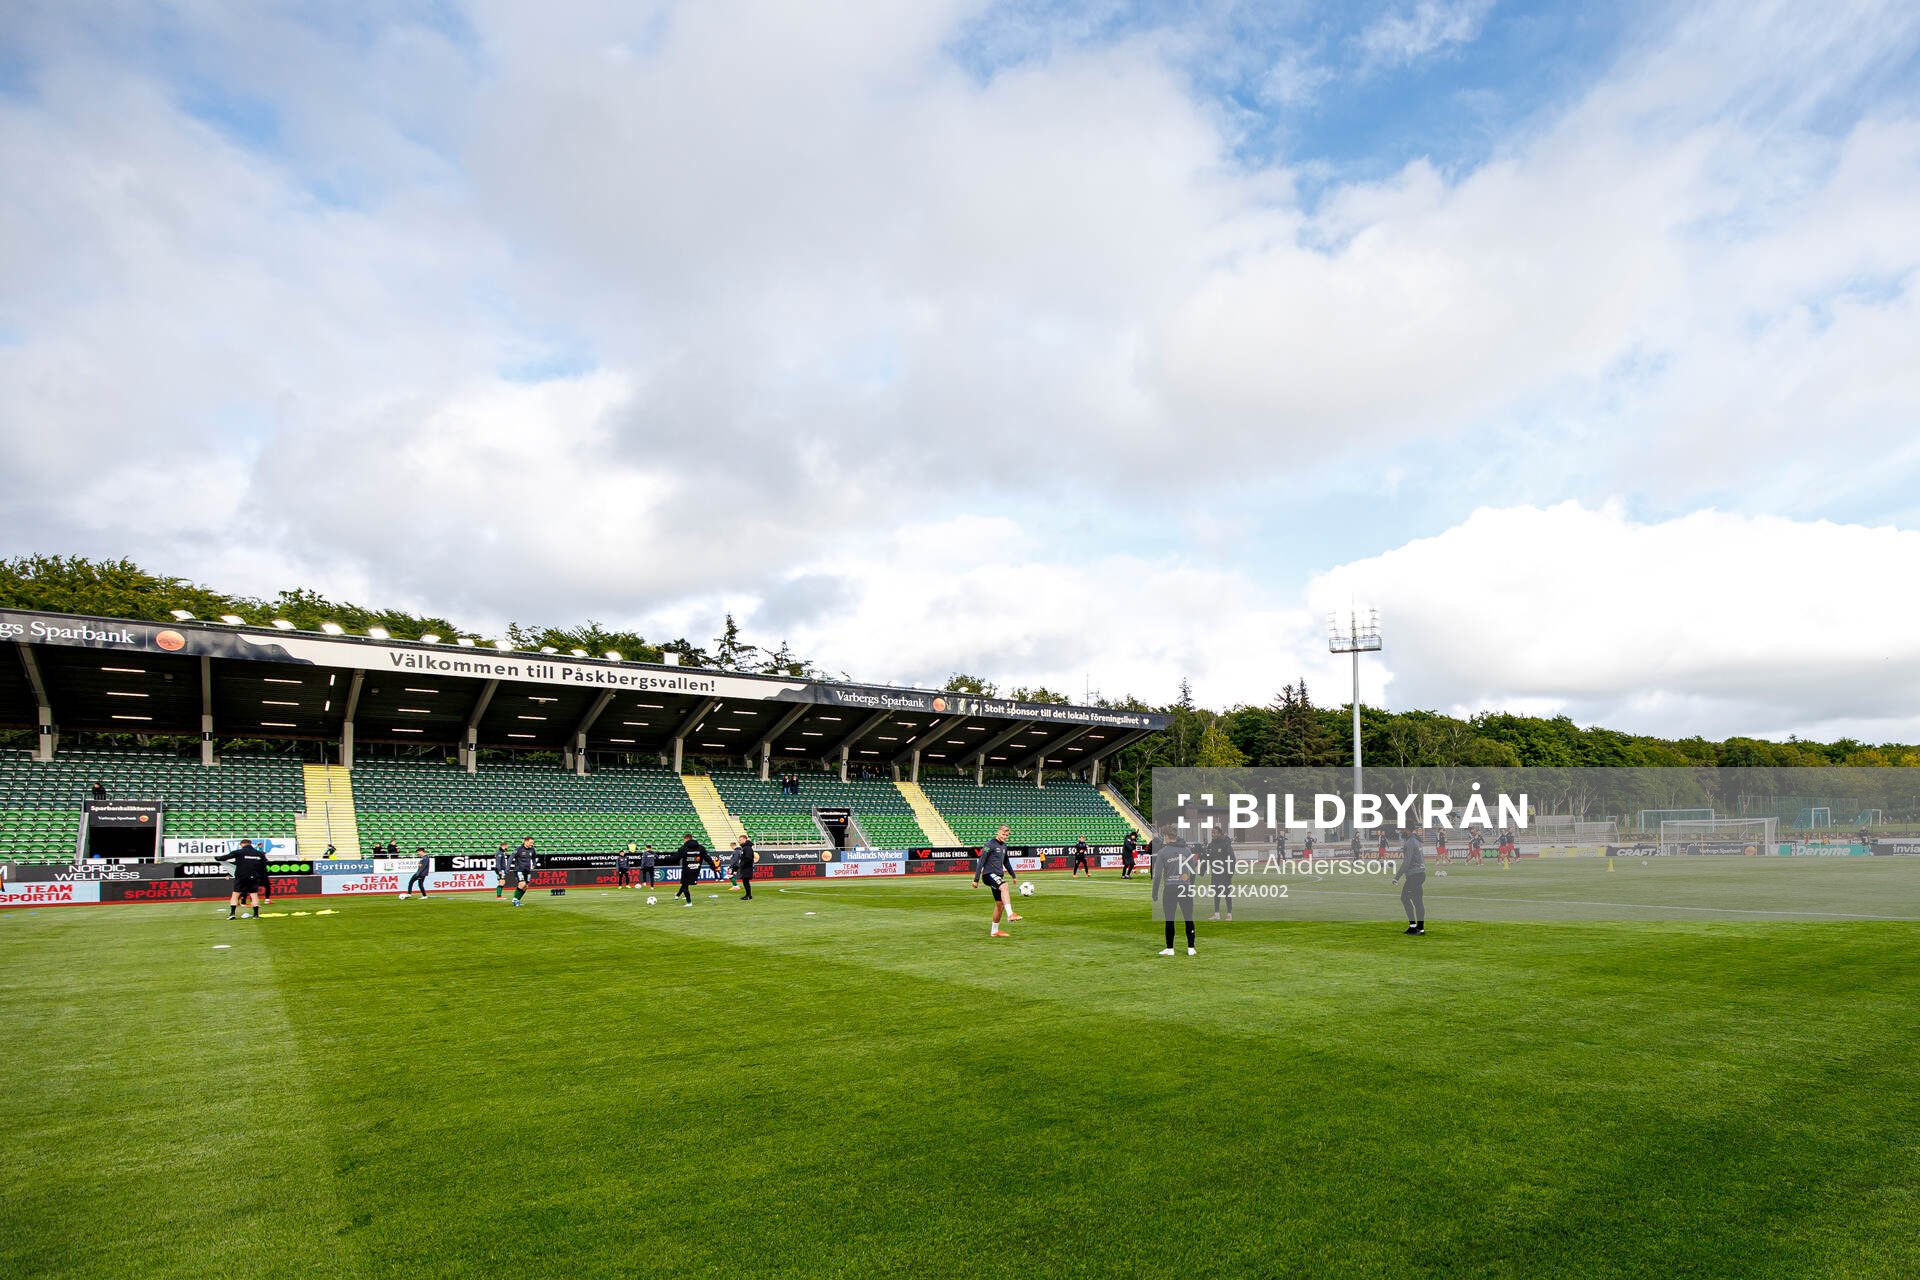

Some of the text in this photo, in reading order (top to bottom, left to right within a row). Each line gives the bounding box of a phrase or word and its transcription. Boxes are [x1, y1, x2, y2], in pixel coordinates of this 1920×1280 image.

[30, 620, 135, 644] Sparbank
[389, 652, 715, 692] Välkommen till Påskbergsvallen!
[836, 690, 924, 708] Varbergs Sparbank
[984, 703, 1139, 725] Stolt sponsor till det lokala föreningslivet
[178, 841, 225, 854] Måleri
[1796, 845, 1851, 856] Derome
[795, 852, 818, 860] Sparbank
[847, 851, 903, 860] Hallands Nyheter
[1616, 848, 1657, 857] CRAFT
[69, 864, 126, 873] NORDIC
[184, 865, 228, 875] UNIBE
[55, 872, 140, 881] WELLNESS
[363, 875, 399, 883] TEAM
[452, 873, 486, 881] TEAM
[529, 877, 567, 885] PORTIA
[150, 880, 193, 889] TEAM
[269, 878, 298, 886] EAM
[433, 880, 486, 888] SPORTIA
[24, 884, 73, 893] TEAM
[342, 883, 398, 891] SPORTIA
[0, 893, 73, 903] SPORTIA
[124, 889, 193, 899] SPORTIA
